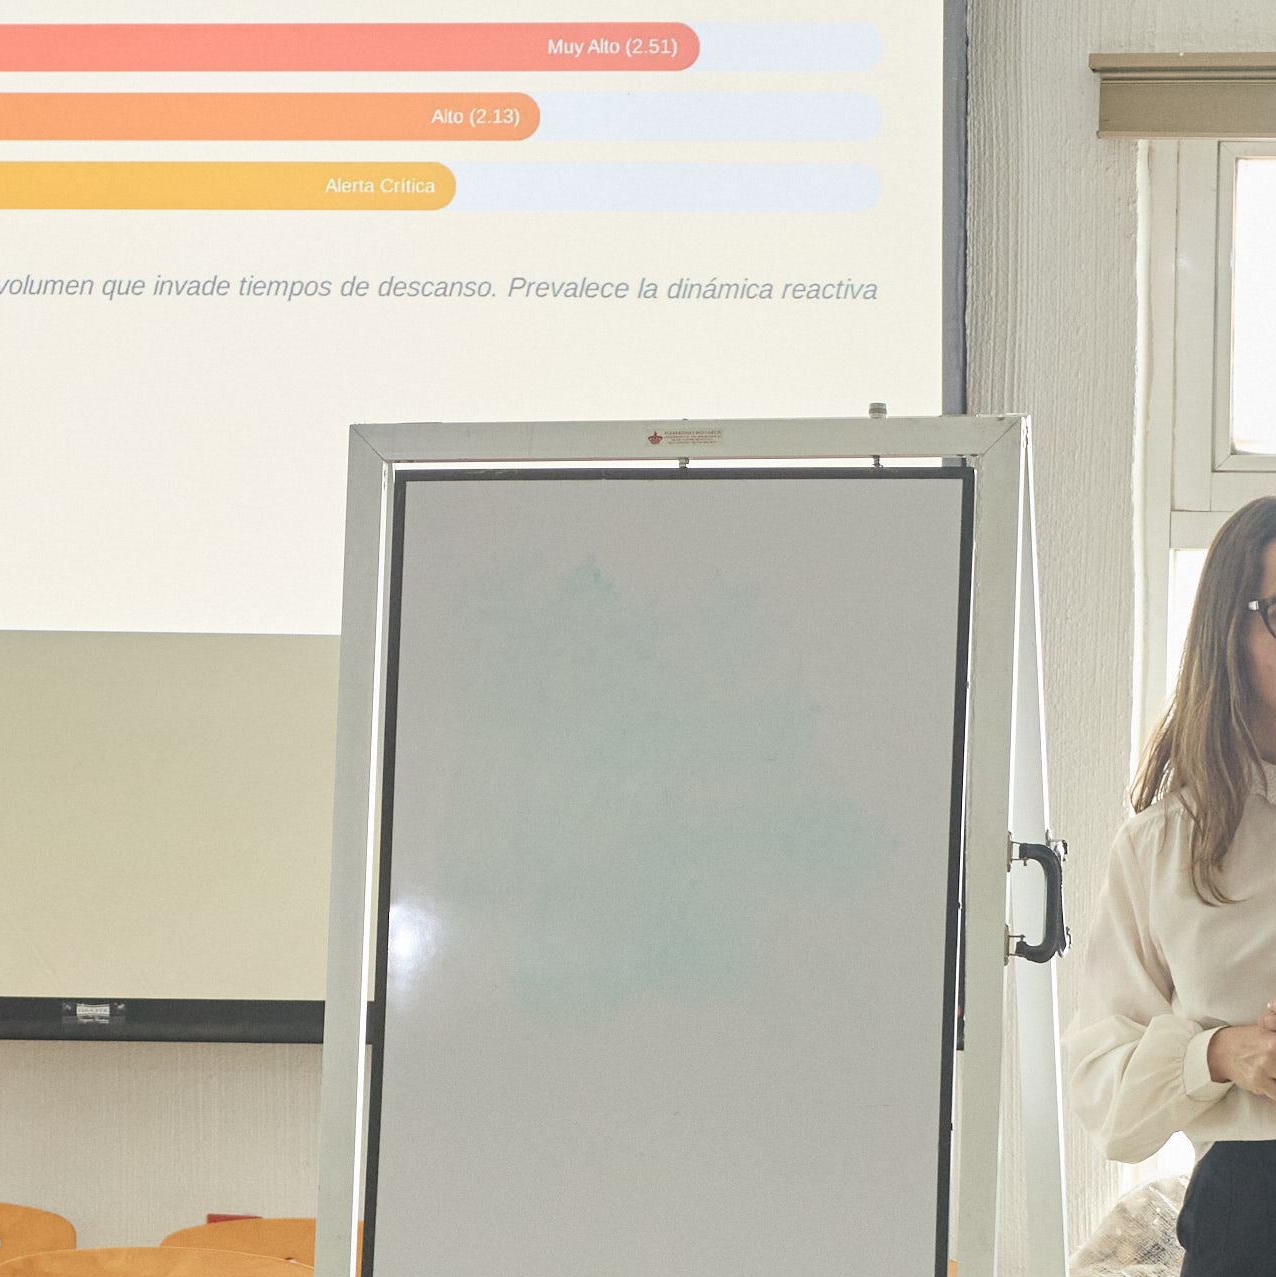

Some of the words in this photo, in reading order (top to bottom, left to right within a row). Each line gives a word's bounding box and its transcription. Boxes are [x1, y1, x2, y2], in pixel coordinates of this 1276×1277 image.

[547, 38, 585, 58] Muy
[586, 37, 621, 55] Alto
[625, 37, 678, 58] (2.51)
[430, 108, 464, 125] Alto
[469, 108, 520, 128] (2.13)
[324, 177, 375, 194] Alerta
[379, 177, 436, 194] Crítica
[101, 279, 146, 302] que
[153, 274, 231, 297] invade
[239, 274, 332, 302] tiempos
[340, 275, 370, 297] de
[378, 275, 496, 298] descanso.
[507, 276, 630, 299] Prevalece
[637, 277, 659, 299] la
[667, 276, 774, 300] dinámica
[781, 277, 878, 300] reactiva
